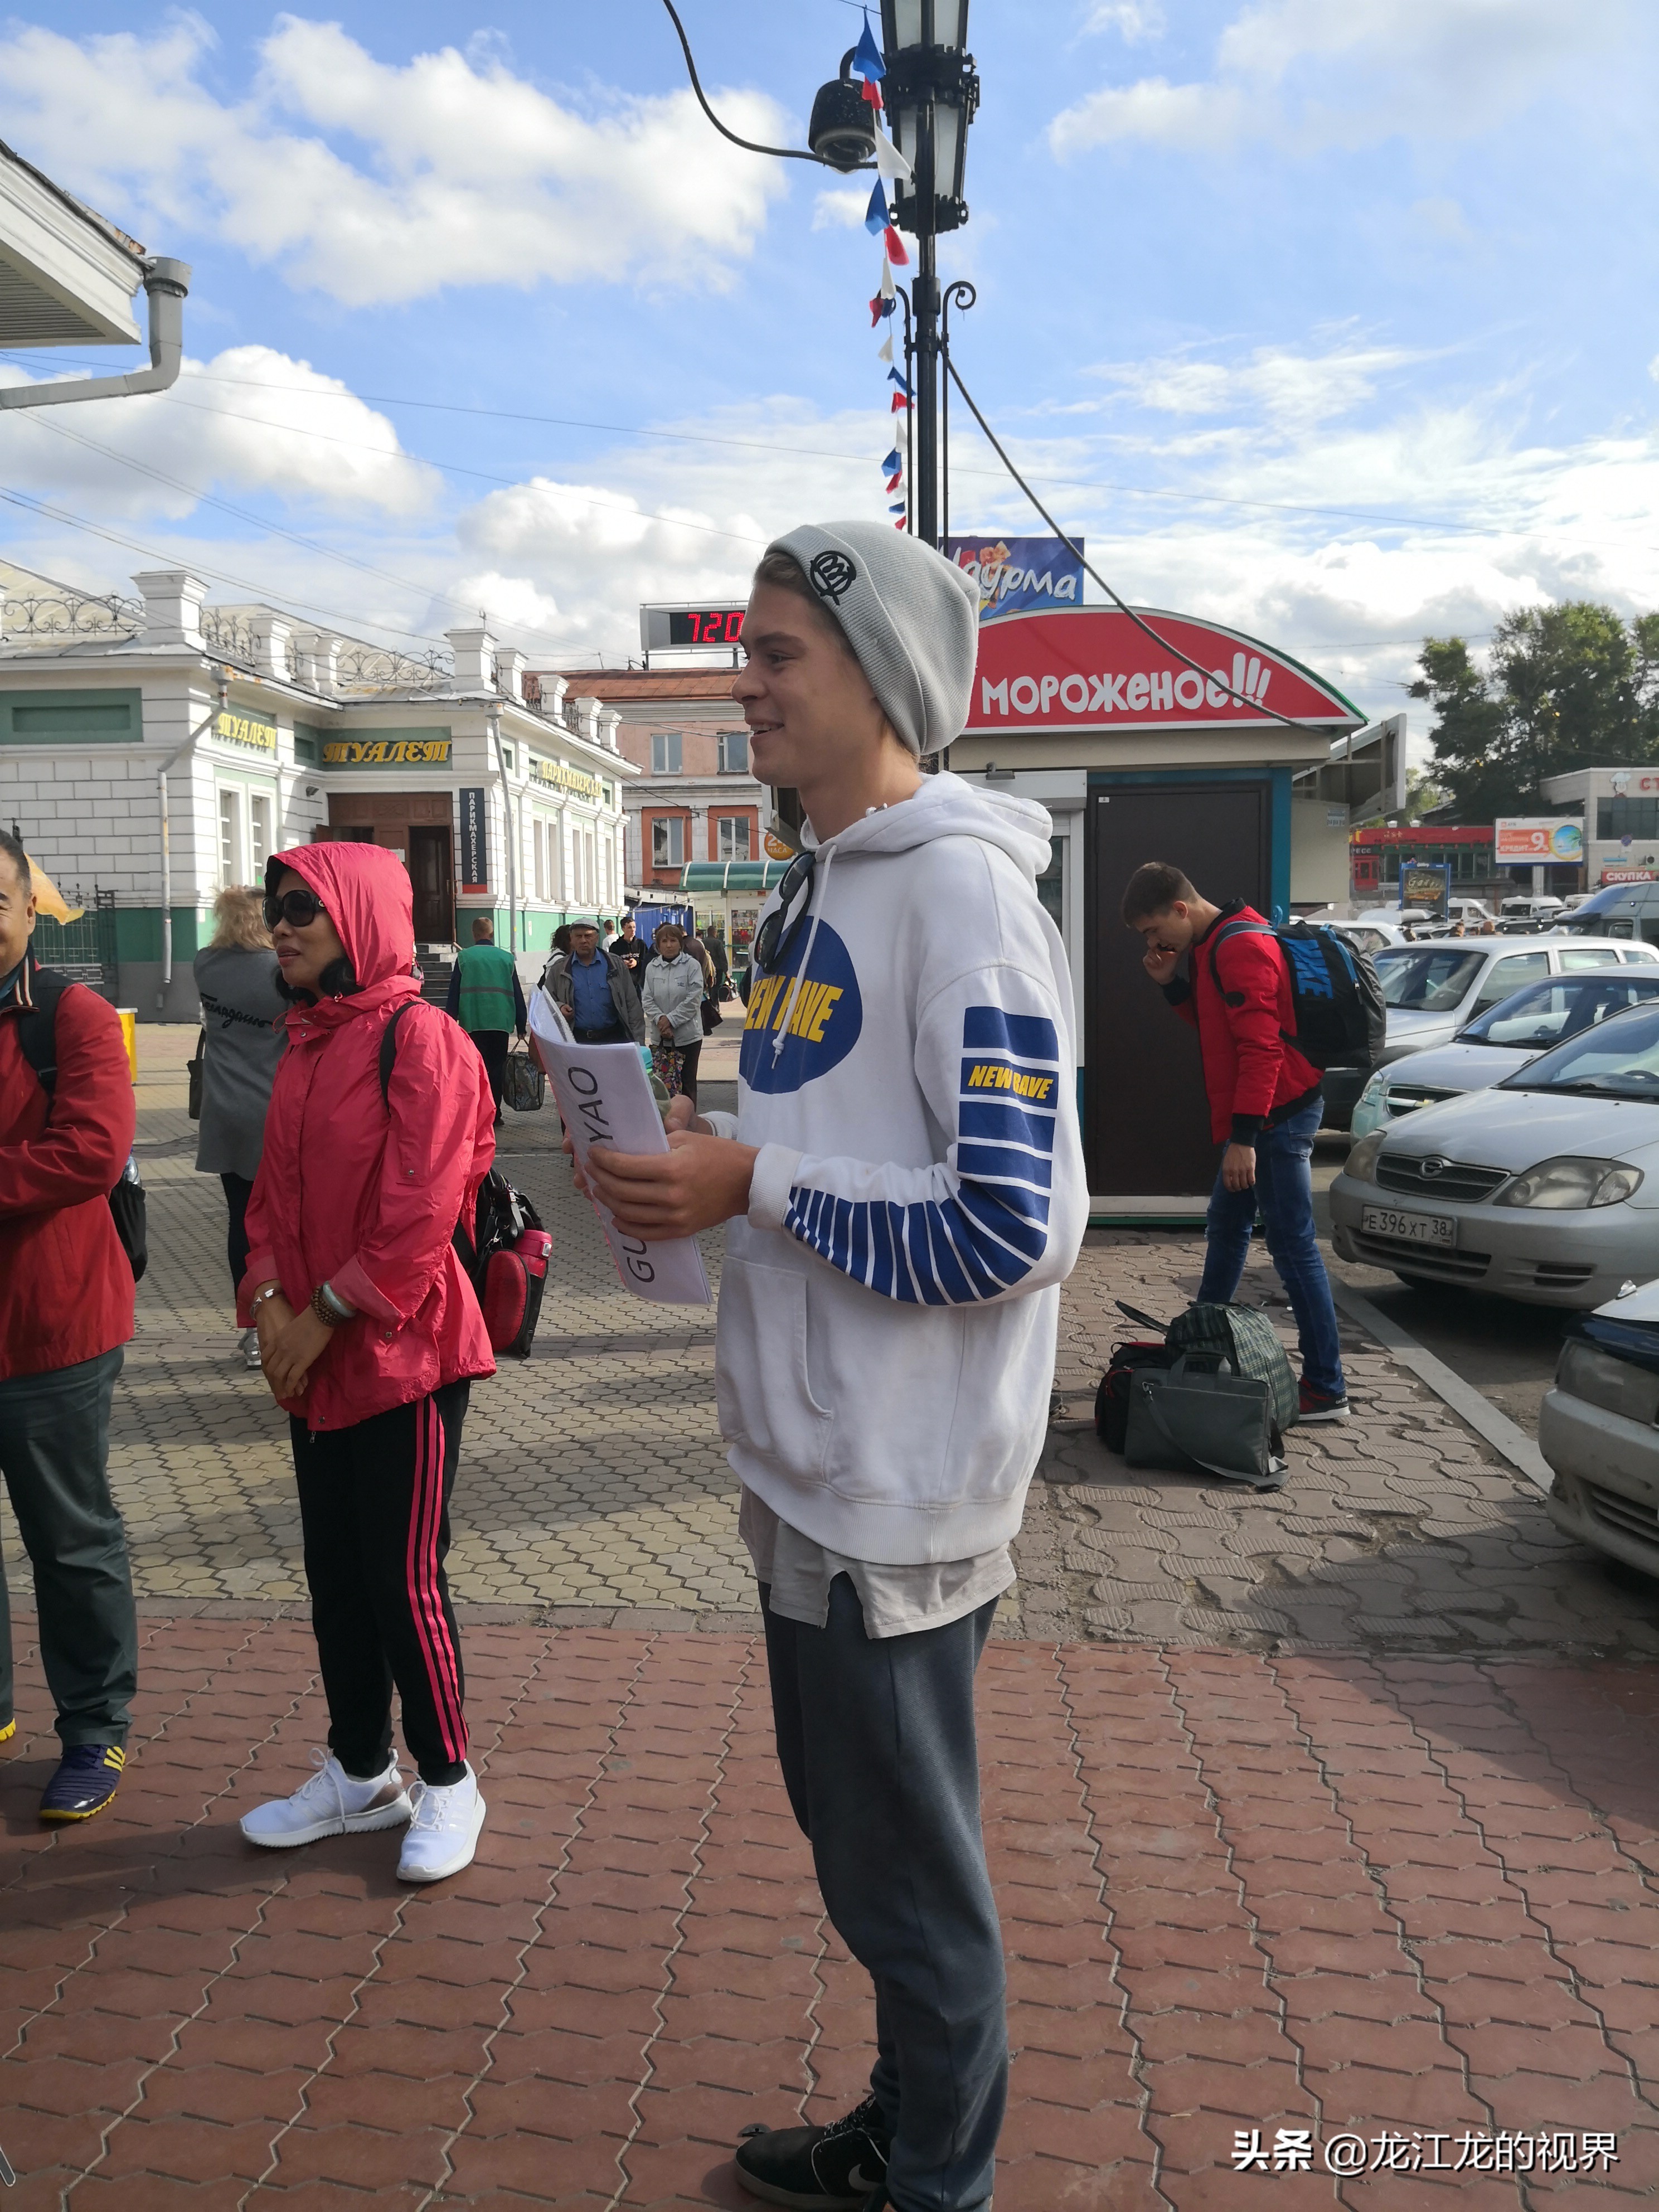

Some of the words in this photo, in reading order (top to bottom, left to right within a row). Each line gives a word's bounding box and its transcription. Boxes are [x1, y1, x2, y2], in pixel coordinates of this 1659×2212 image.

[938, 545, 1076, 601] аурма
[322, 740, 452, 763] ТУАЛЕТ
[542, 761, 603, 798] ПАРИКМАХЕРСКАЯ
[468, 792, 478, 883] ПАРИКМАХЕРСКАЯ
[1605, 871, 1652, 882] СКУПКА
[1282, 937, 1334, 1000] NIKE
[567, 1066, 613, 1142] YAO
[968, 1065, 1013, 1089] NEW
[1013, 1071, 1054, 1100] RAVE
